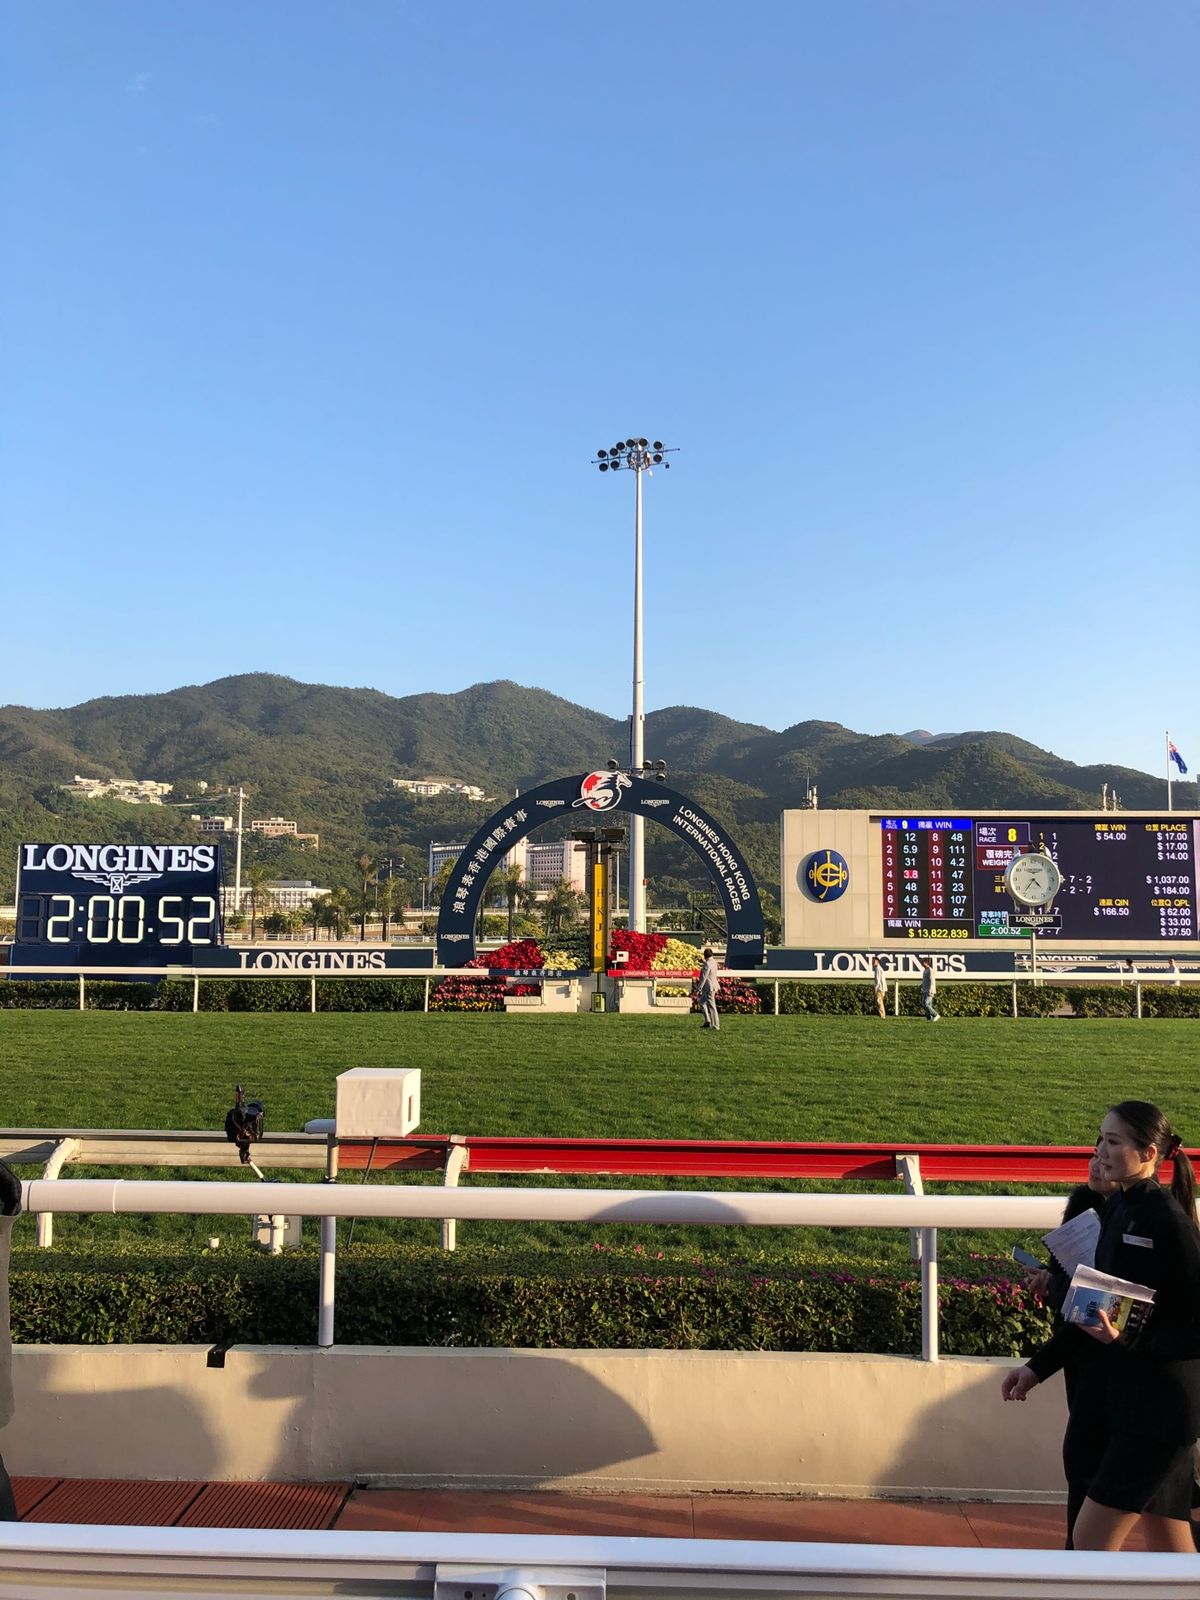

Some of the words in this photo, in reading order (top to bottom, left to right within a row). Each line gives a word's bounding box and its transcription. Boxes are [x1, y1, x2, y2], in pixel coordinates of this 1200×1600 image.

[887, 833, 891, 841] 1
[905, 832, 916, 841] 12
[932, 833, 938, 841] 8
[951, 833, 963, 841] 48
[1008, 828, 1017, 842] 8
[1039, 832, 1044, 840] 1
[1052, 832, 1057, 840] 1
[1096, 832, 1101, 841] $
[1156, 832, 1163, 841] $
[886, 845, 892, 853] 2
[903, 845, 918, 854] 5.9
[932, 845, 938, 854] 9
[949, 845, 965, 854] 111
[1039, 842, 1044, 850] 2
[1052, 842, 1058, 850] 7
[1157, 842, 1163, 851] $
[678, 805, 720, 844] LONGINES
[717, 842, 738, 871] HONG
[734, 870, 751, 900] KONG
[1052, 852, 1058, 860] 2
[1157, 852, 1163, 860] $
[1165, 852, 1188, 860] 14.00
[23, 844, 215, 872] LONGINES
[887, 857, 893, 866] 3
[904, 858, 915, 866] 31
[931, 858, 942, 866] 10
[950, 858, 965, 867] 4.2
[672, 814, 728, 877] INTERNATIONAL
[724, 877, 742, 912] RACES
[887, 870, 893, 878] 4
[903, 870, 918, 879] 3.8
[931, 870, 941, 879] 11
[952, 871, 963, 879] 47
[1069, 875, 1075, 883] 7
[1086, 875, 1092, 883] 2
[1146, 875, 1152, 884] $
[1154, 876, 1189, 884] 1,037.00
[887, 883, 893, 891] 5
[905, 883, 917, 891] 48
[931, 883, 943, 891] 12
[952, 883, 964, 892] 23
[1070, 886, 1076, 894] 2
[1086, 886, 1092, 894] 7
[1154, 886, 1160, 895] $
[1162, 886, 1190, 895] 184.00
[887, 895, 893, 903] 6
[904, 895, 918, 904] 4.6
[932, 895, 943, 904] 13
[950, 896, 967, 904] 107
[1114, 899, 1129, 907] QIN
[1174, 899, 1190, 907] QPL
[888, 907, 893, 916] 7
[906, 908, 917, 916] 12
[932, 908, 943, 917] 14
[953, 908, 964, 917] 87
[1038, 907, 1042, 915] 1
[1054, 907, 1060, 915] 7
[1093, 907, 1099, 916] $
[1102, 908, 1129, 916] 166.50
[1160, 907, 1166, 916] $
[1167, 908, 1191, 916] 62.00
[47, 895, 215, 944] 2:00.52
[595, 889, 604, 950] HKJC
[1160, 918, 1166, 926] $
[1168, 918, 1191, 926] 33.00
[908, 928, 915, 938] $
[917, 929, 968, 939] 13,822,839
[990, 927, 1021, 935] 2:00.52
[1160, 928, 1166, 936] $
[1168, 928, 1192, 936] 37.50
[239, 951, 386, 968] LONGINES
[814, 953, 967, 972] LONGINES
